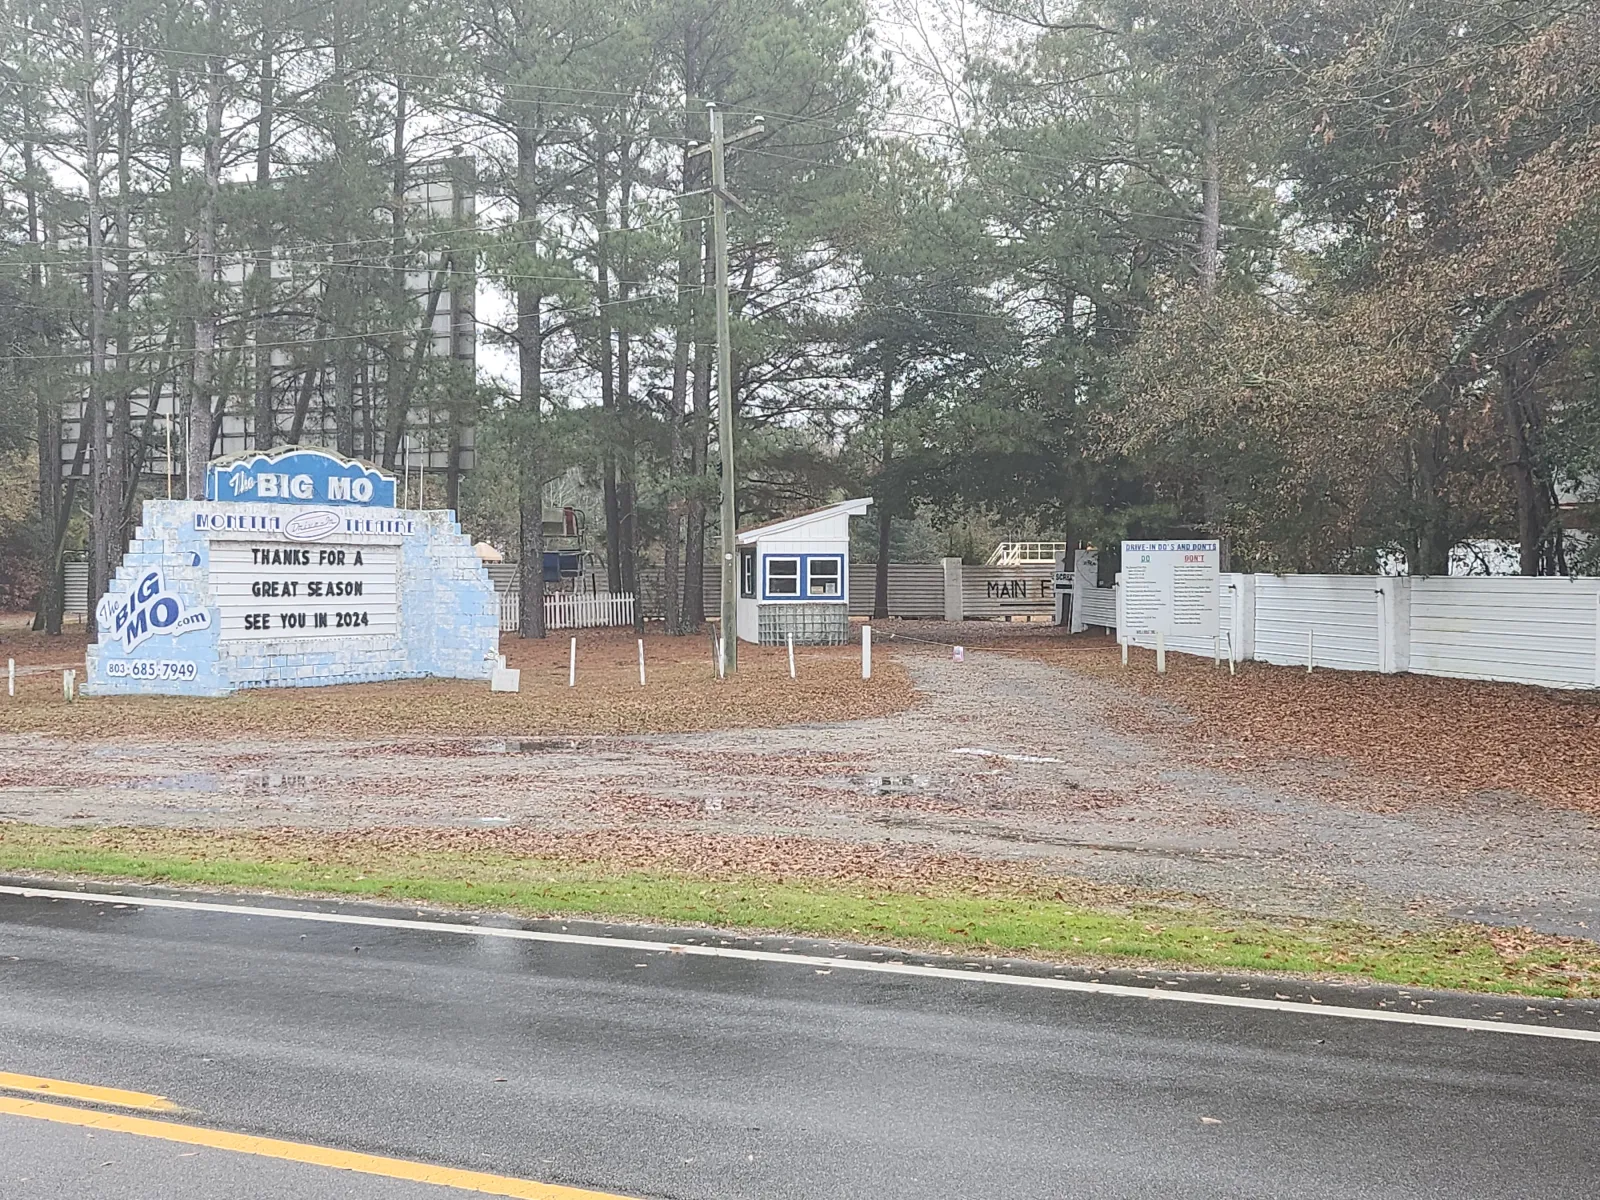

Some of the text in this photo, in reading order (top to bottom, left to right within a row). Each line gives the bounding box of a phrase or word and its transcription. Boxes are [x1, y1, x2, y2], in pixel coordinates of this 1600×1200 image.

[229, 471, 374, 502] The BIG MO
[196, 514, 280, 530] MONETTA
[345, 518, 415, 534] THEATRE
[1177, 543, 1191, 551] AND
[251, 549, 363, 566] THANKS FOR A
[252, 581, 363, 597] GREAT SEASON
[987, 580, 1027, 598] MAIN
[100, 572, 160, 633] The BIG
[244, 611, 369, 630] SEE YOU IN 2024
